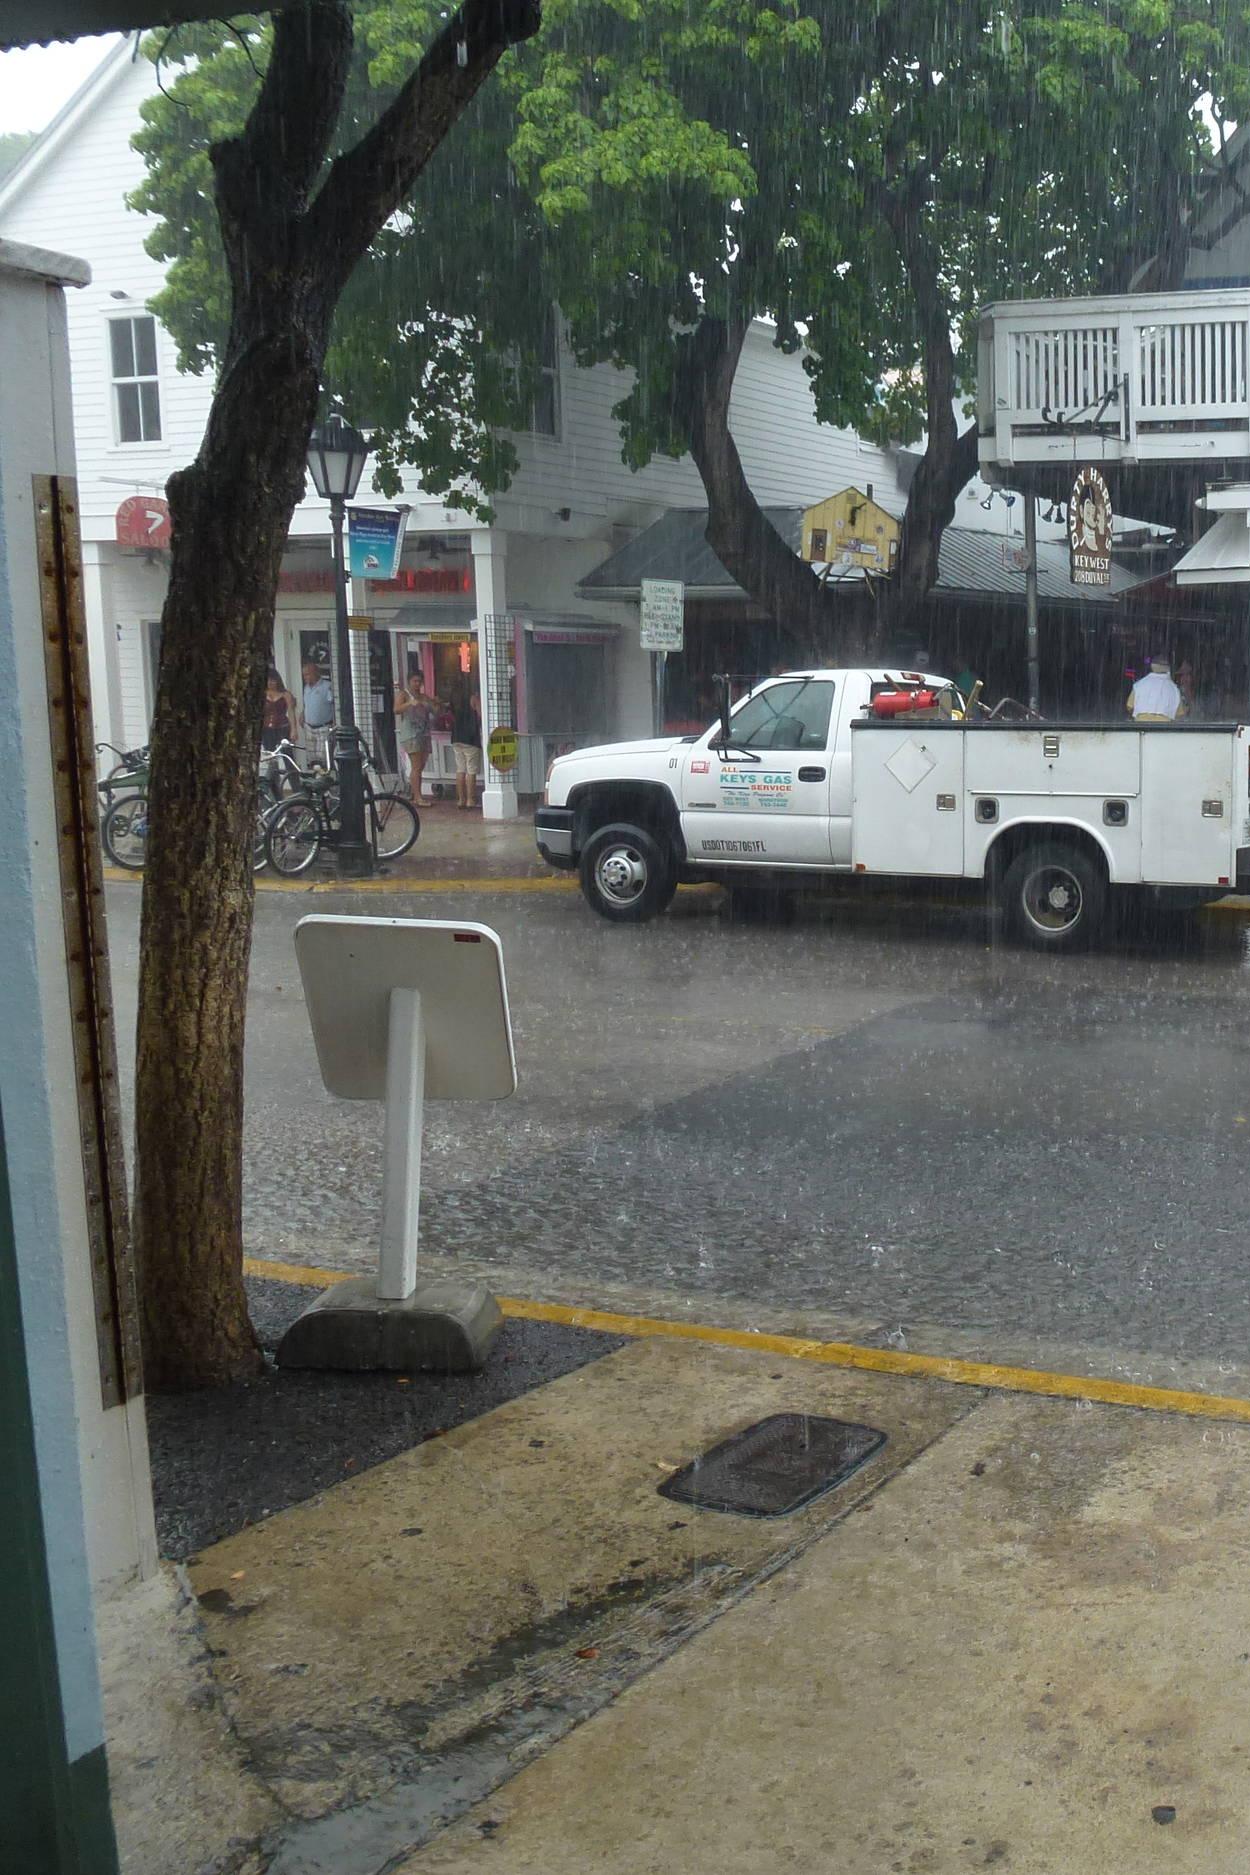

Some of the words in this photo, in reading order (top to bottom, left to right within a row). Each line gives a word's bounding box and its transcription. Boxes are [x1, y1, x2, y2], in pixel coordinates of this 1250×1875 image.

[120, 533, 169, 548] SALOO
[1075, 555, 1088, 567] KEY
[1089, 558, 1110, 570] WEST
[669, 758, 678, 769] 01
[720, 774, 756, 784] KEYS
[764, 775, 792, 785] GAS
[751, 784, 792, 792] SERVICE
